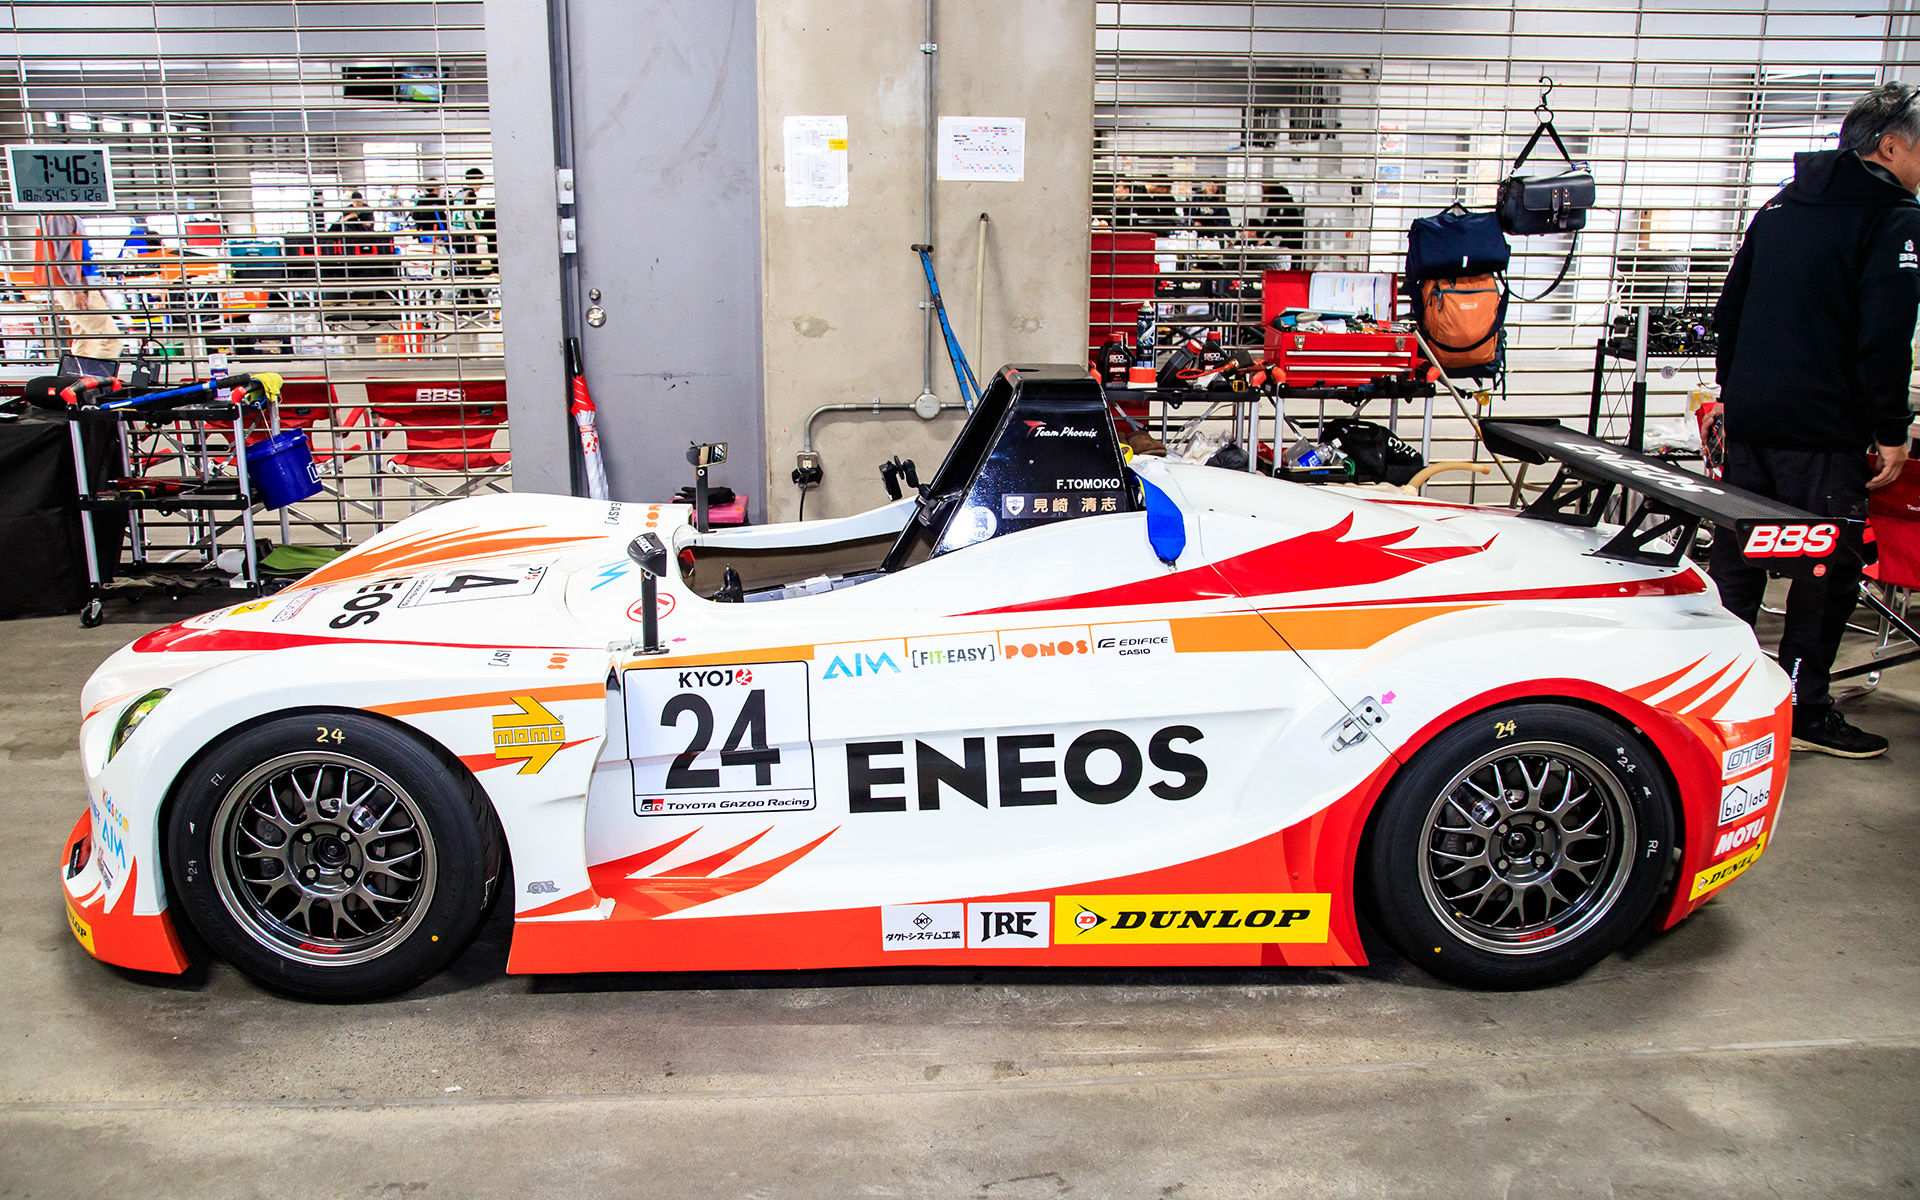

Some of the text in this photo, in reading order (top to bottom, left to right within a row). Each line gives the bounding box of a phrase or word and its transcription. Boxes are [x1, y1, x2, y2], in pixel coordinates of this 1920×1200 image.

[33, 155, 90, 185] 7:46
[416, 388, 462, 402] BBS
[1034, 426, 1097, 438] Team Phoenix
[1554, 442, 1725, 495] ENEOS
[1056, 478, 1121, 490] F.TOMOKO
[1743, 524, 1838, 555] BBS
[1005, 639, 1089, 660] PONOS
[1119, 636, 1168, 646] EDIFICE
[1119, 648, 1151, 656] CASIO
[316, 726, 346, 745] 24
[493, 726, 566, 745] momo
[1494, 719, 1517, 739] 24
[660, 689, 781, 790] 24
[846, 725, 1208, 813] ENEOS
[667, 801, 717, 811] TOYOTA
[719, 799, 765, 809] GAZOO
[767, 797, 811, 808] Racing
[1725, 788, 1770, 818] bio labo
[1646, 839, 1659, 859] RL
[1110, 909, 1311, 930] DUNLOP
[885, 931, 961, 942] ダクトシステム工業
